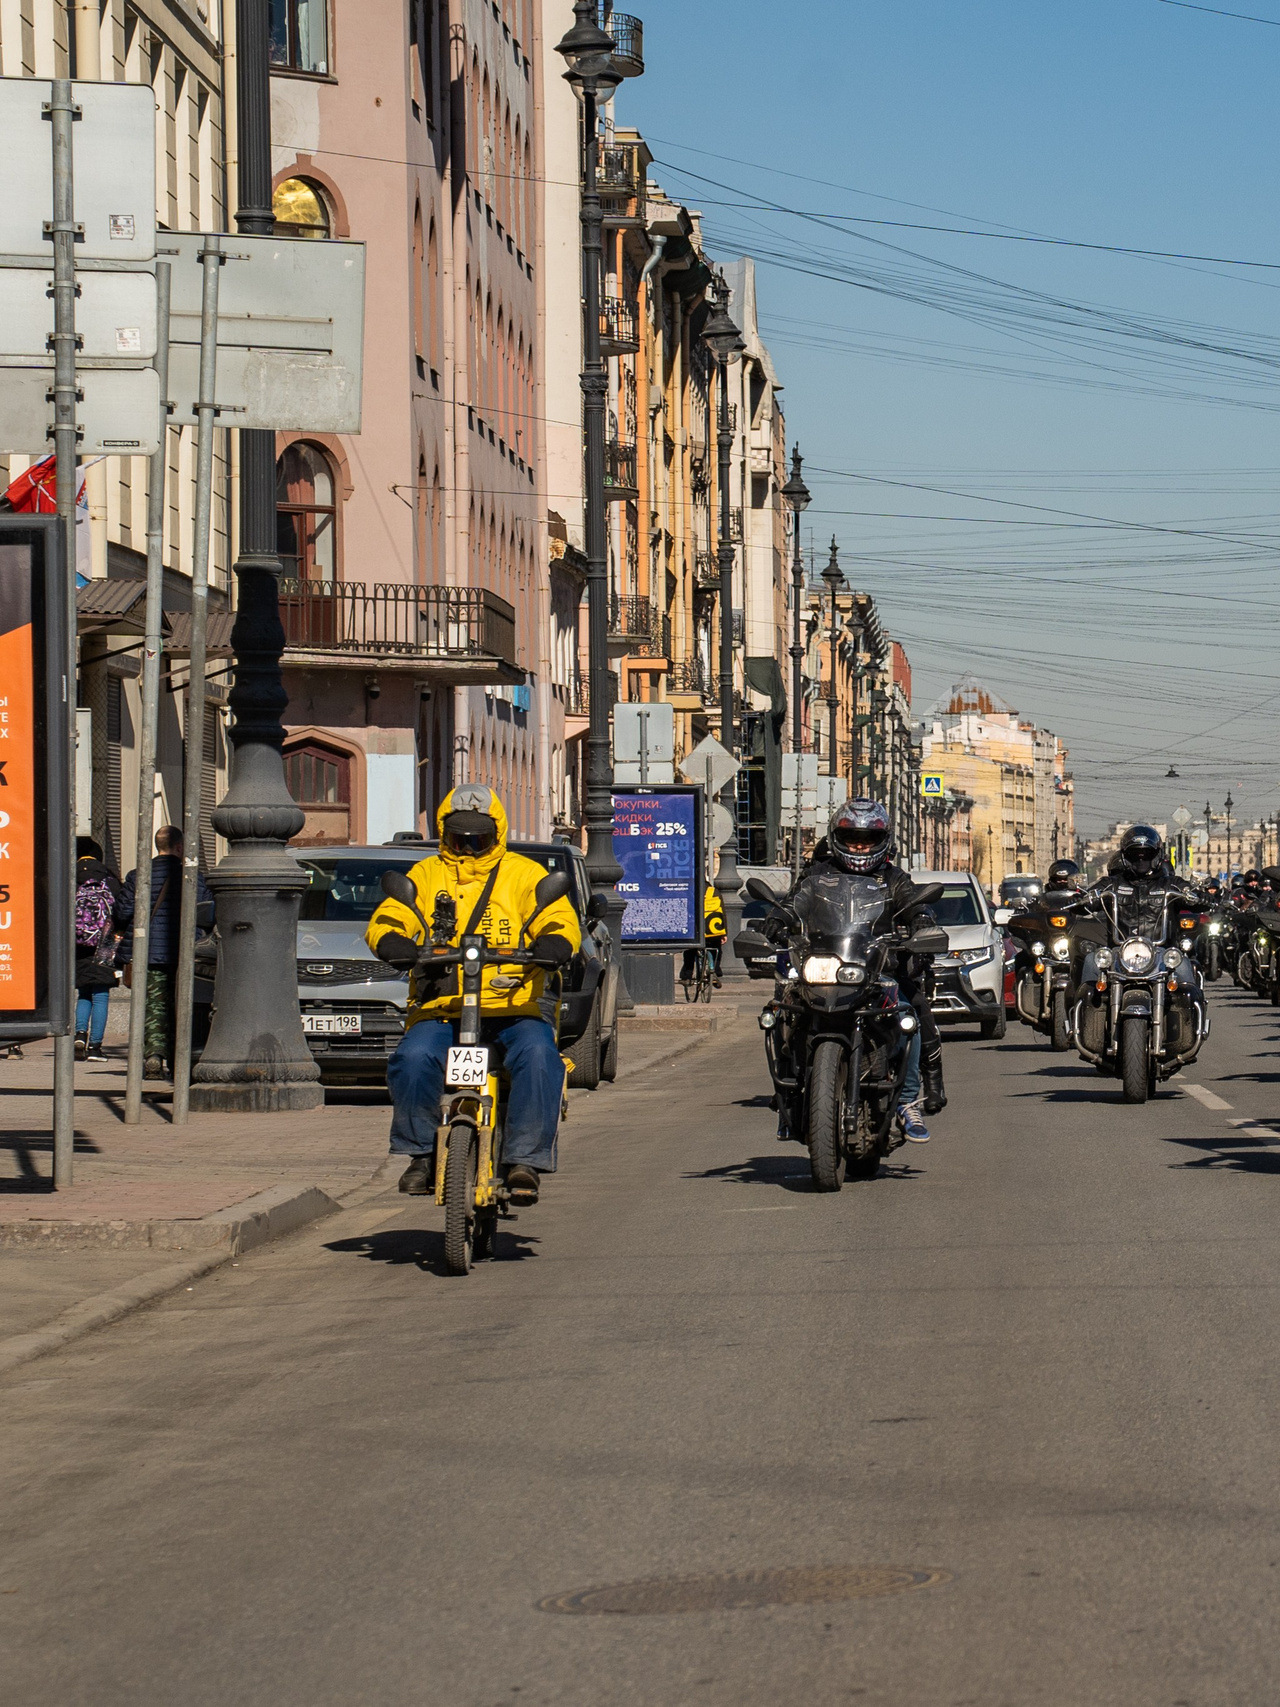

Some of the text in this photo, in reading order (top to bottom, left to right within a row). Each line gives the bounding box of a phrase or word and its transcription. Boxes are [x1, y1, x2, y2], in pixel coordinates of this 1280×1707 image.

[611, 798, 662, 811] окупки.
[610, 814, 655, 824] кидки.
[656, 822, 687, 836] 25%
[618, 883, 640, 892] ПСБ
[496, 918, 510, 946] Еда
[336, 1016, 357, 1027] 198
[451, 1068, 484, 1082] 56М
